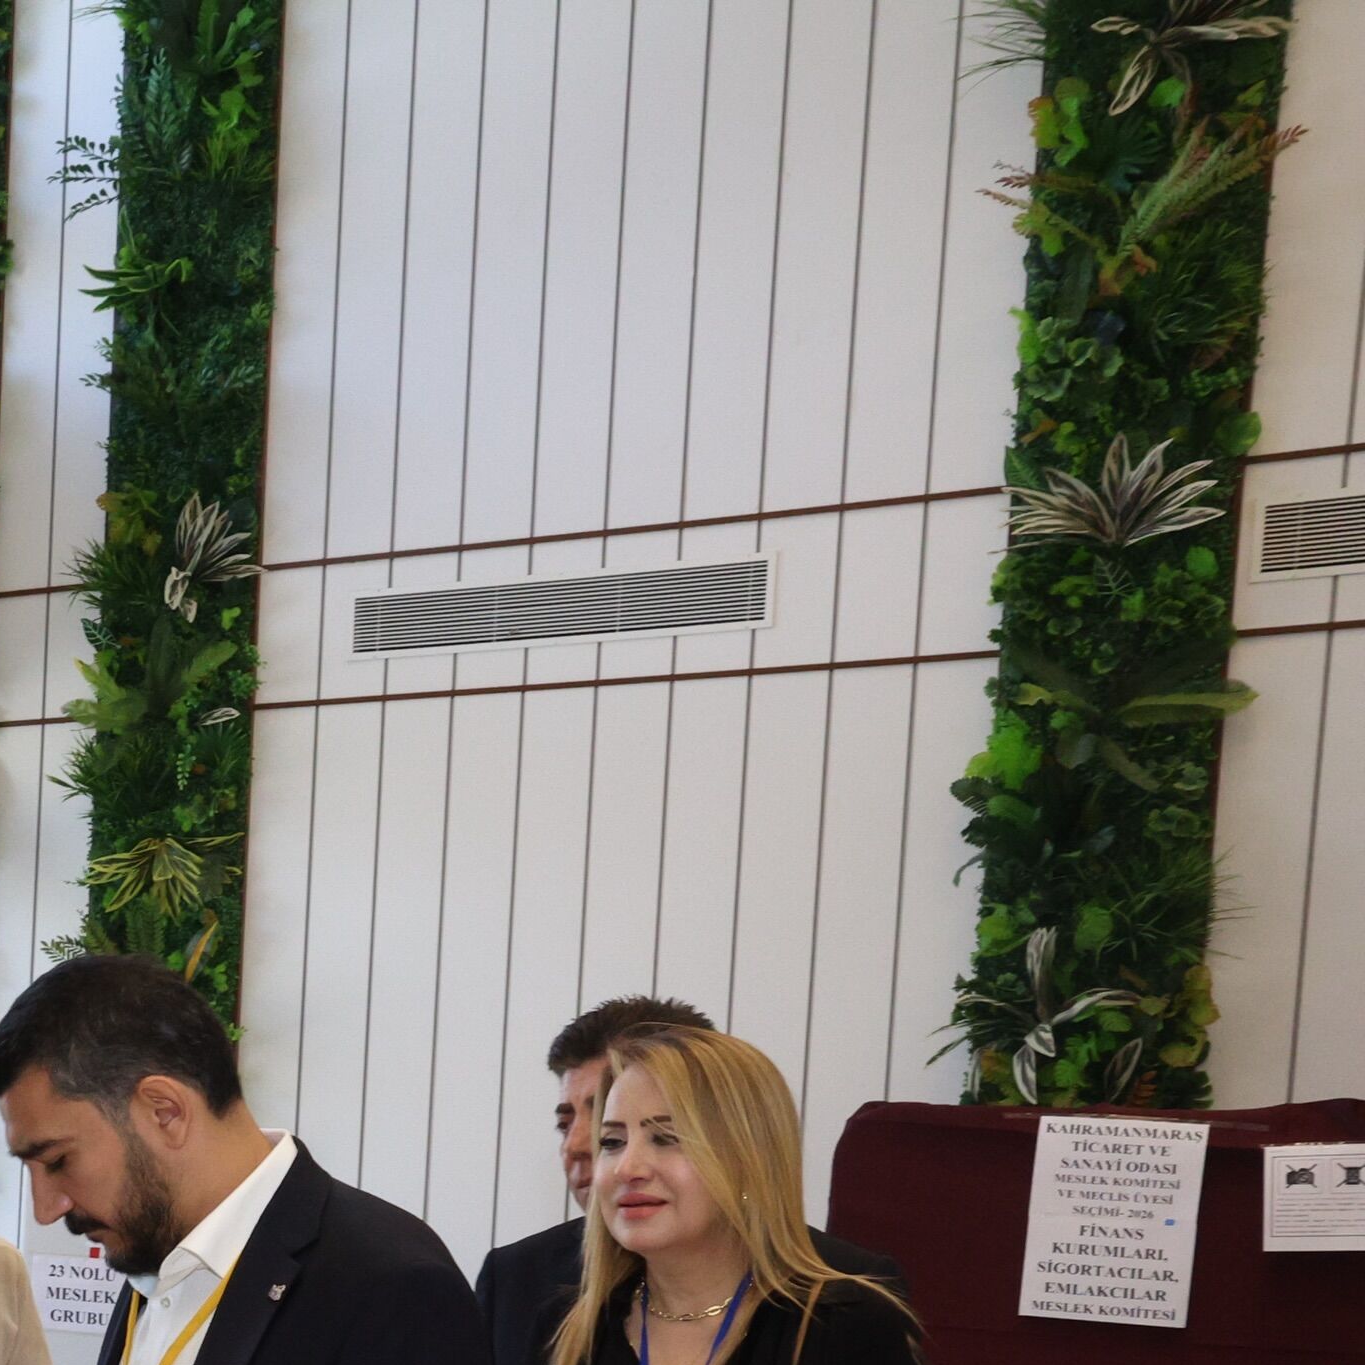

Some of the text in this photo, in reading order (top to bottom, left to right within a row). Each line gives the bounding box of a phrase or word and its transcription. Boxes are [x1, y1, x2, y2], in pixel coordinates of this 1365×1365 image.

[1046, 1122, 1204, 1144] KAHRAMANMARAŞ
[1071, 1140, 1171, 1157] TİCARET VE
[1061, 1157, 1177, 1175] SANAYİ ODASI
[1055, 1173, 1180, 1190] MESLEK KOMİTESİ
[1057, 1189, 1075, 1198] VE
[1128, 1208, 1154, 1220] 2026
[1079, 1223, 1145, 1240] FİNANS
[48, 1264, 116, 1282] 23 NOLU
[46, 1286, 117, 1304] MESLEK
[1044, 1281, 1167, 1302] EMLAKCILAR
[50, 1308, 109, 1326] GRUBU
[1032, 1300, 1176, 1321] MESLEK KOMİTESİ
